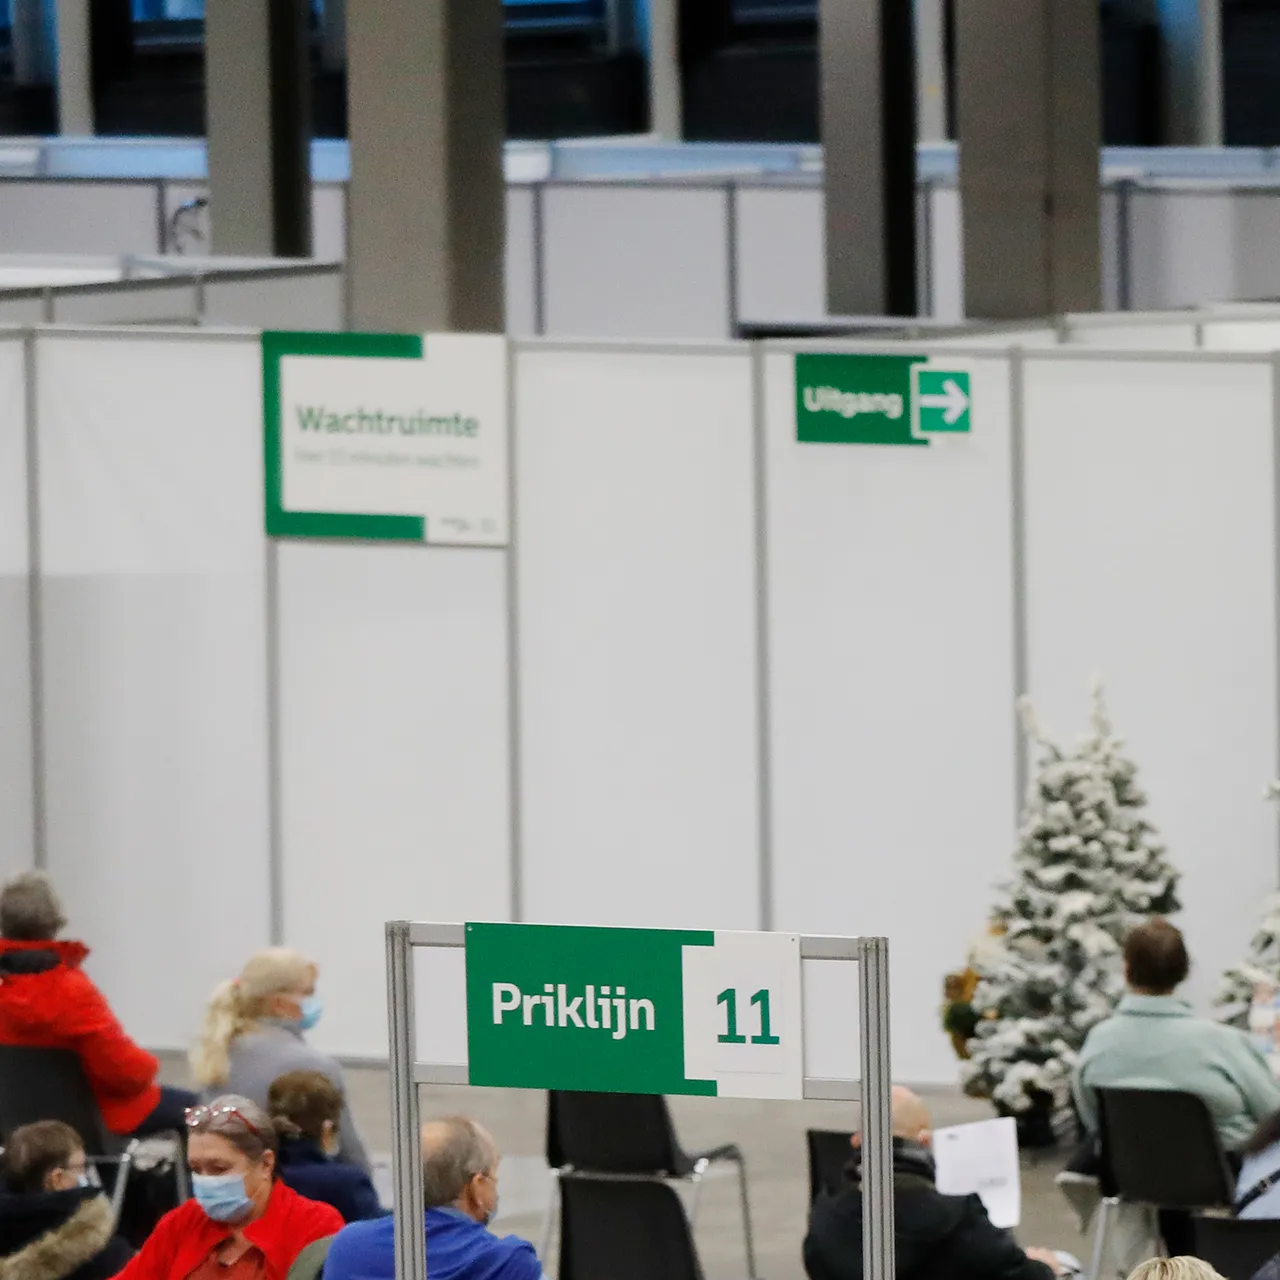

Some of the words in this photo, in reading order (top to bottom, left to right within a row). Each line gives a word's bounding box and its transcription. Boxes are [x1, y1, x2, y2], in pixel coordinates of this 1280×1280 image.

[296, 405, 479, 438] Wachtruimte
[492, 982, 656, 1040] Priklijn
[716, 988, 780, 1045] 11
